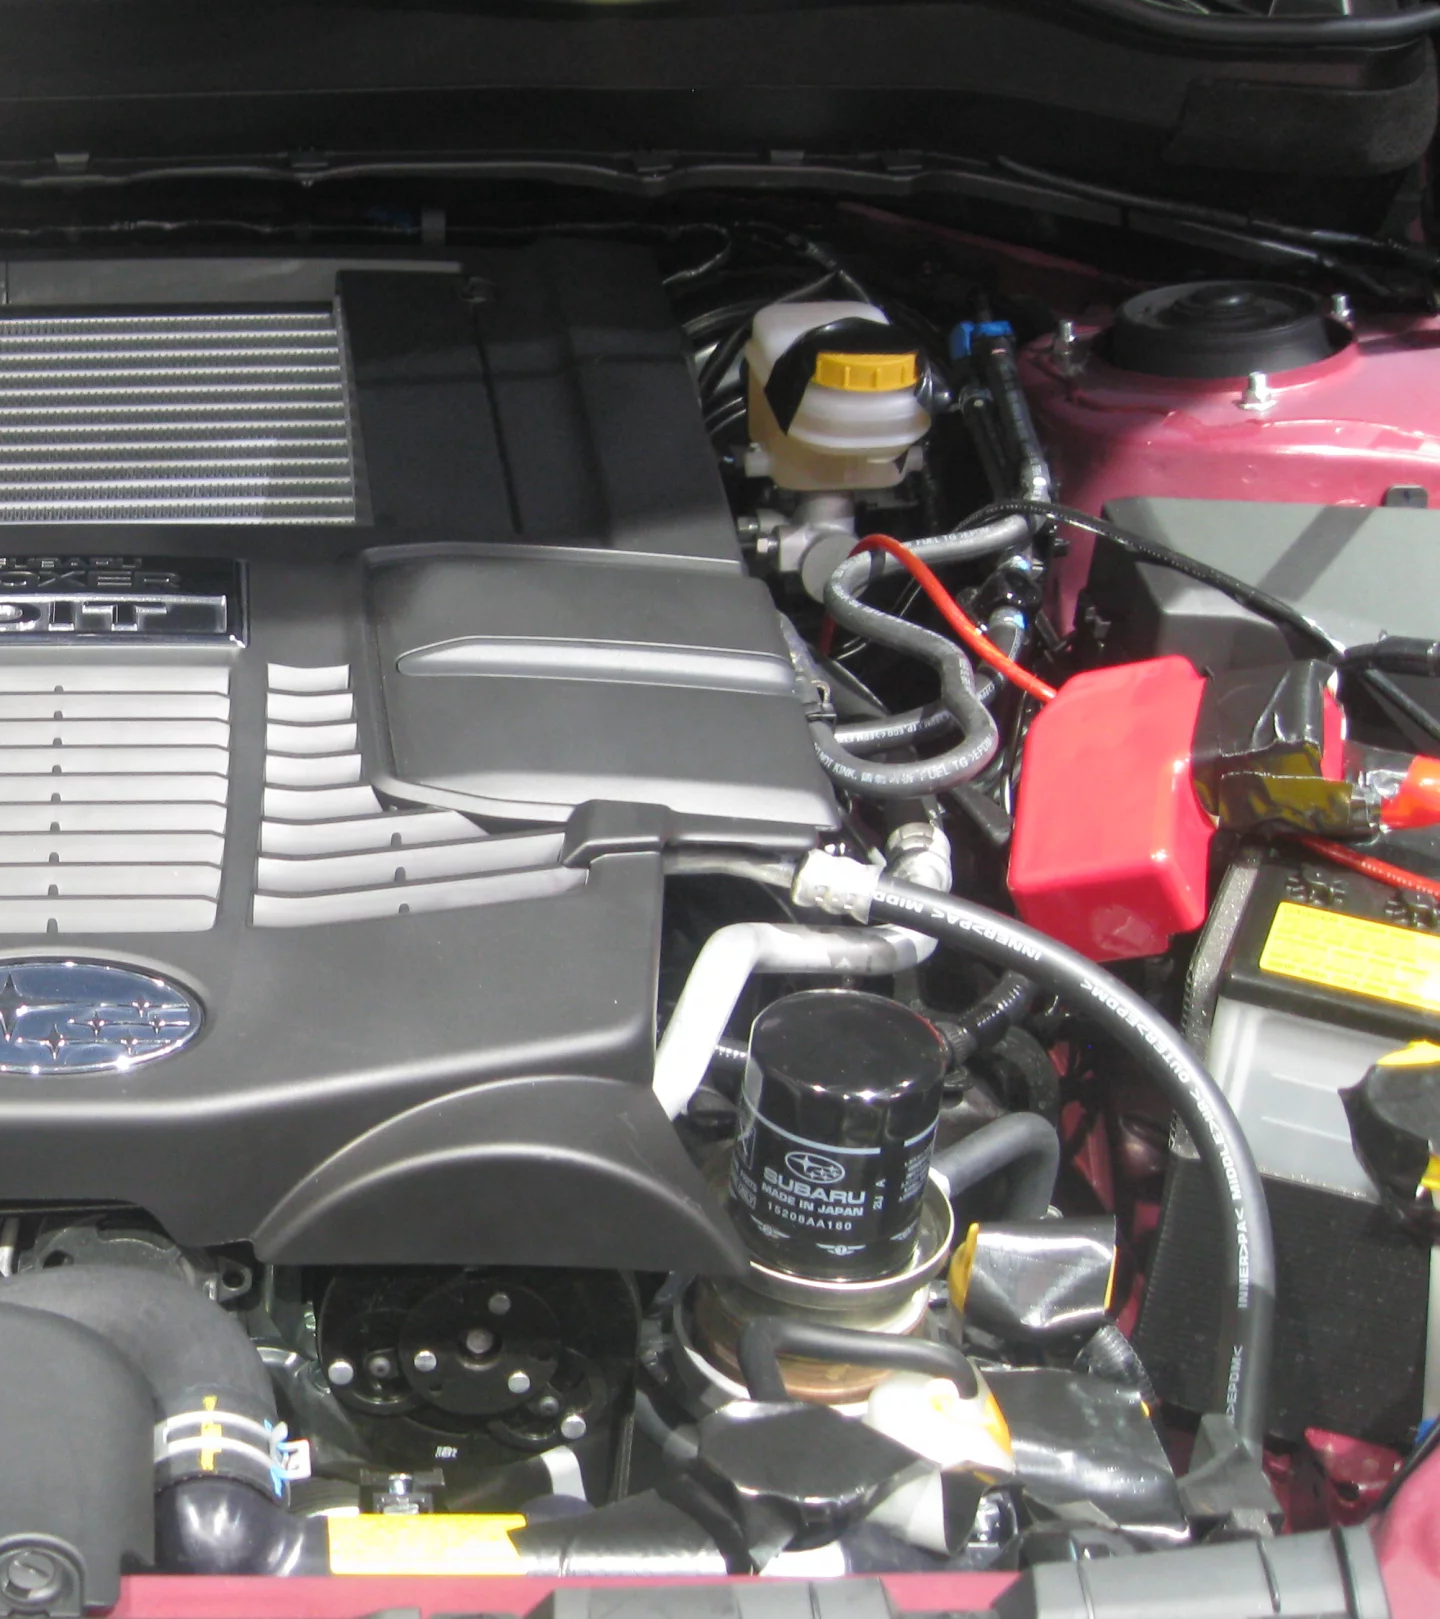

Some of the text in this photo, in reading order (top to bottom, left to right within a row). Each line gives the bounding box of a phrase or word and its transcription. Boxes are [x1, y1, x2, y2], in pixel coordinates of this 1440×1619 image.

[760, 1181, 864, 1217] MADE IN JAPAN
[763, 1166, 866, 1205] SUBARU
